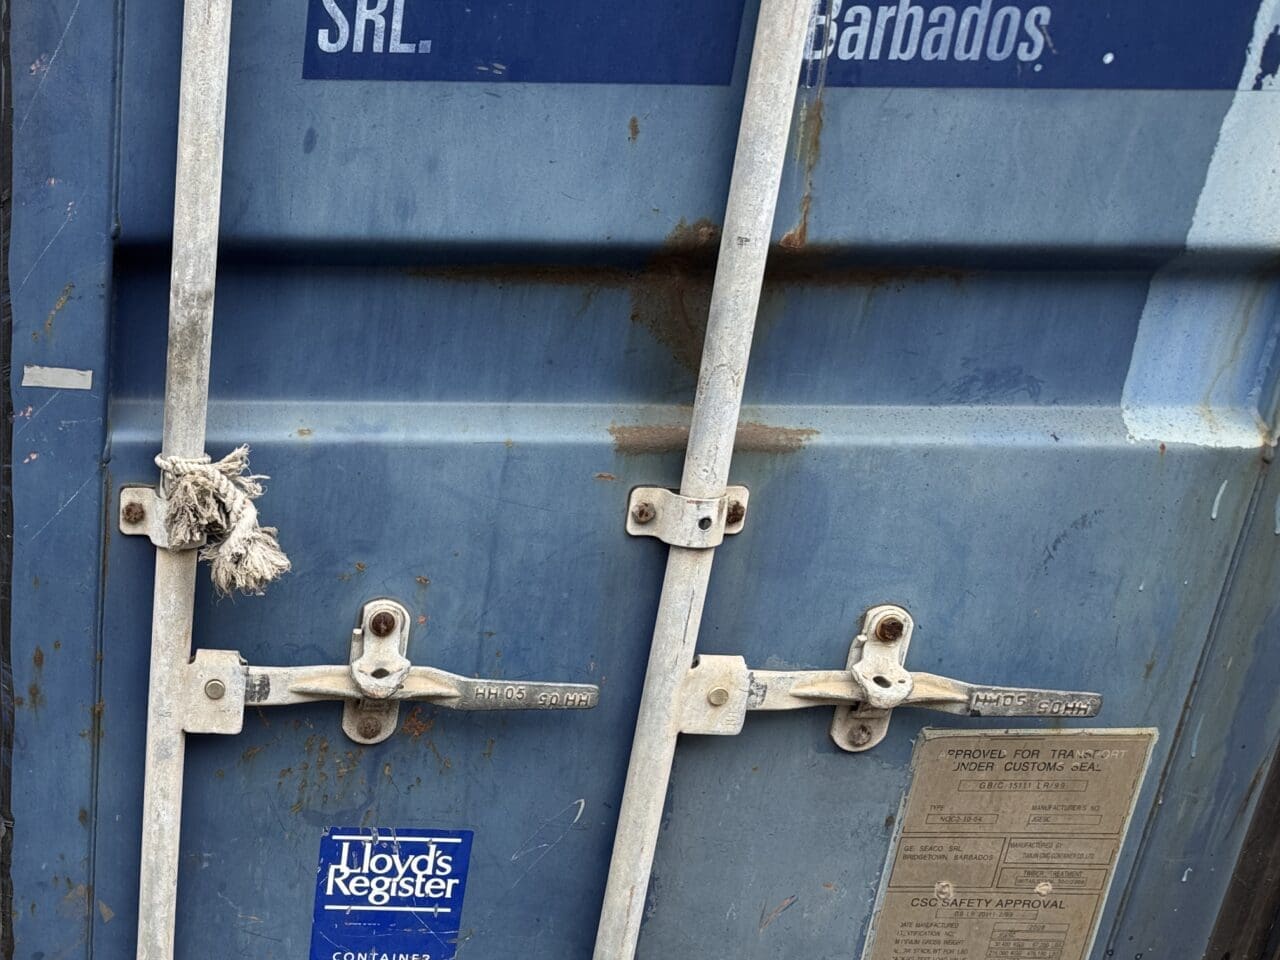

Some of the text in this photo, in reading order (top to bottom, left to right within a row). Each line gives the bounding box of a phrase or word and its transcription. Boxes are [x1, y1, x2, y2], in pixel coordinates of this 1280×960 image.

[318, 0, 432, 53] SRL.
[803, 0, 1052, 61] Barbados
[1004, 762, 1065, 772] CUSTOMS
[1070, 762, 1102, 772] SEAL
[1014, 749, 1040, 759] FOR
[336, 842, 453, 882] Lloyd's
[326, 864, 460, 905] Register
[910, 898, 1066, 909] CSC SAFETY APPROVAL
